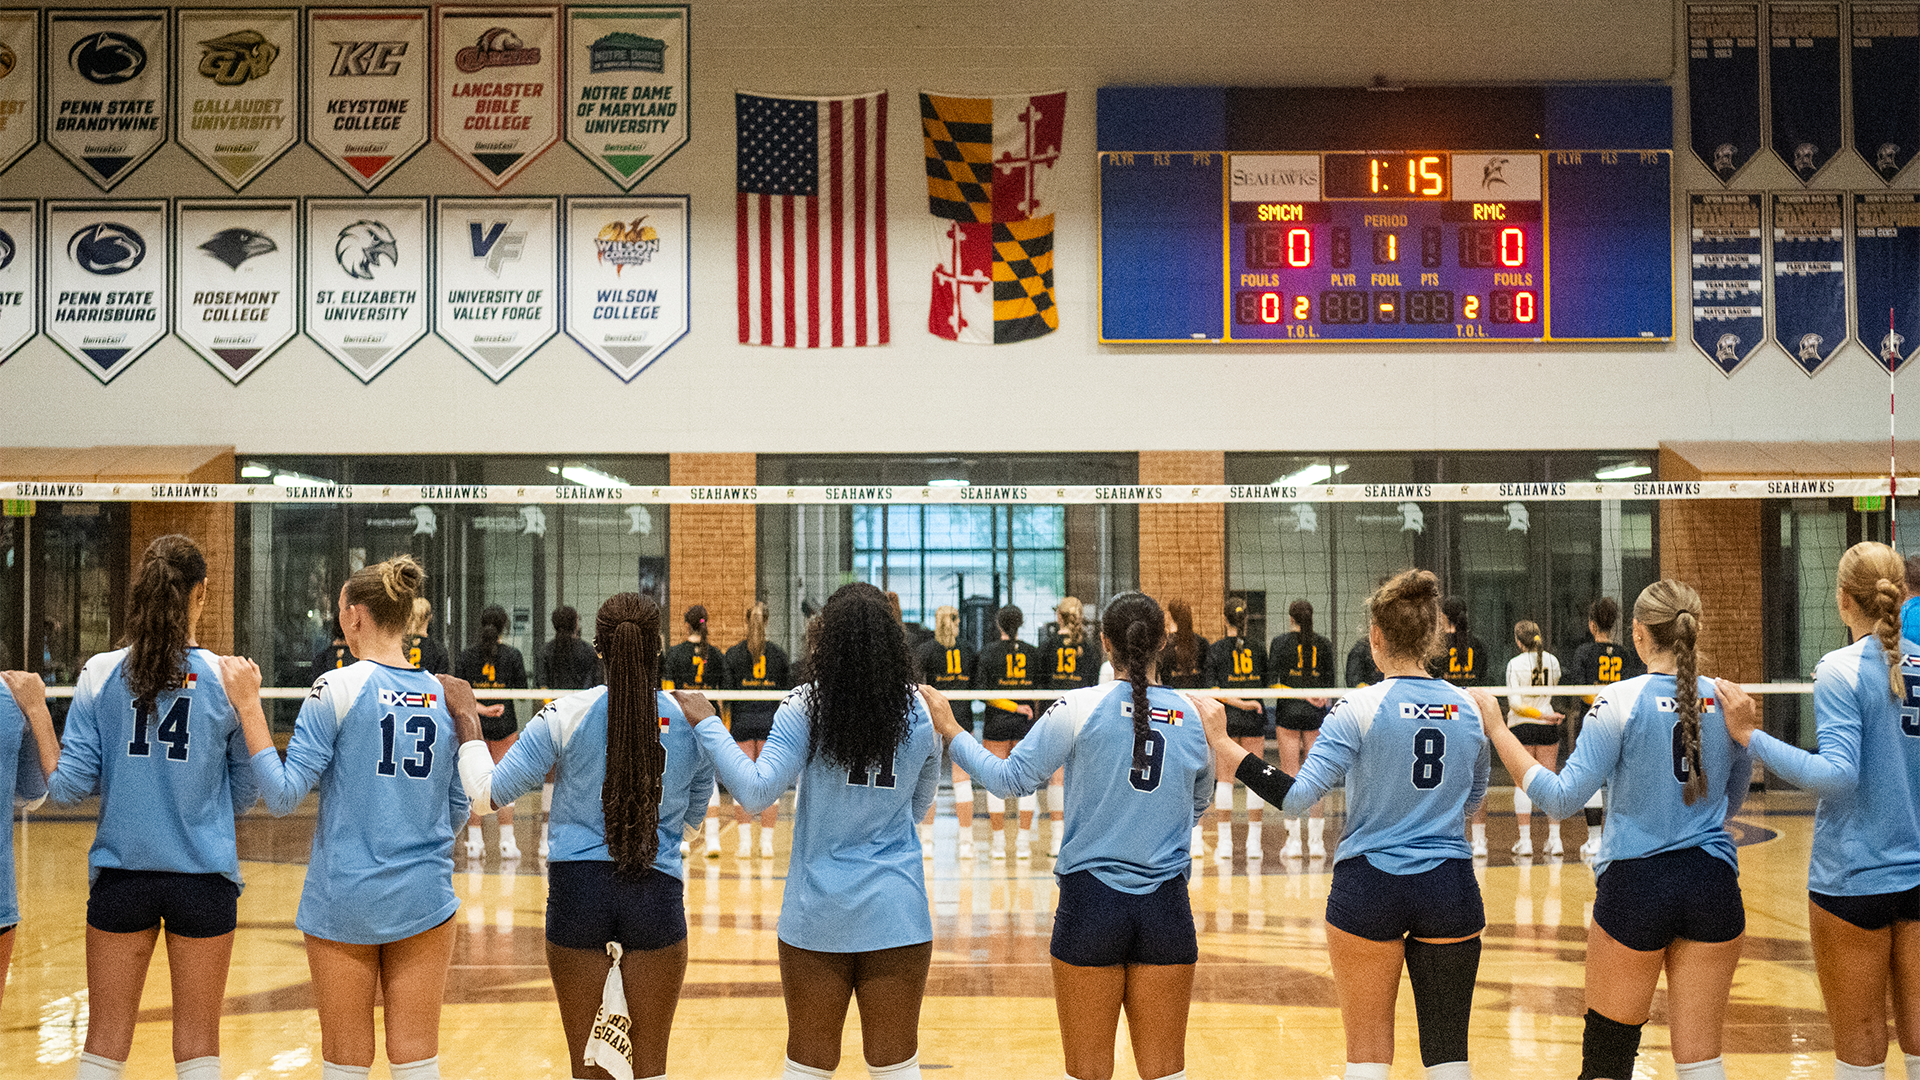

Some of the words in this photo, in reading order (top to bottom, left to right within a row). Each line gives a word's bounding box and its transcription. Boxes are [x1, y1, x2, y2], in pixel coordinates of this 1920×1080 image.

[452, 82, 545, 98] LANCASTER
[582, 86, 632, 100] NOTRE
[633, 86, 673, 100] DAME
[60, 100, 101, 115] PENN
[107, 100, 155, 115] STATE
[193, 99, 284, 114] GALLAUDET
[327, 98, 410, 114] KEYSTONE
[475, 99, 520, 114] BIBLE
[577, 103, 595, 117] OF
[600, 103, 677, 117] MARYLAND
[56, 116, 160, 131] BRANDYWINE
[191, 116, 285, 131] UNIVERSITY
[333, 115, 401, 131] COLLEGE
[464, 116, 533, 131] COLLEGE
[585, 119, 670, 134] UNIVERSITY
[1109, 153, 1134, 166] PLYR
[1153, 153, 1170, 166] FLS
[1193, 153, 1211, 166] PTS
[1557, 152, 1582, 165] PLYR
[1601, 152, 1618, 165] FLS
[1641, 152, 1658, 165] PTS
[1233, 169, 1318, 186] SEAHAWKS
[1371, 157, 1443, 195] 1:15
[1258, 204, 1303, 221] SMCM
[1473, 203, 1506, 221] RMC
[1364, 214, 1408, 228] PERIOD
[594, 238, 660, 254] WILSON
[1288, 228, 1311, 268] 0
[1501, 227, 1524, 267] 0
[1240, 273, 1280, 287] FOULS
[1331, 273, 1356, 287] PLYR
[1371, 273, 1401, 287] FOUL
[1420, 273, 1439, 287] PTS
[1494, 272, 1533, 287] FOULS
[59, 291, 101, 305] PENN
[106, 291, 154, 305] STATE
[193, 291, 280, 306] ROSEMONT
[316, 291, 337, 305] ST.
[342, 290, 417, 304] ELIZABETH
[449, 289, 524, 304] UNIVERSITY
[527, 289, 543, 304] OF
[597, 289, 658, 303] WILSON
[55, 307, 157, 322] HARRISBURG
[203, 307, 270, 322] COLLEGE
[324, 307, 409, 321] UNIVERSITY
[453, 306, 498, 321] VALLEY
[502, 306, 543, 321] FORGE
[593, 306, 660, 321] COLLEGE
[1261, 292, 1280, 324] 0
[1294, 295, 1310, 320] 2
[1464, 295, 1479, 320] 2
[1515, 291, 1534, 323] 0
[1286, 325, 1320, 338] T.O.L.
[1456, 324, 1489, 338] T.O.L.
[17, 483, 83, 497] SEAHAWKS
[151, 485, 218, 498] SEAHAWKS
[286, 485, 353, 499] SEAHAWKS
[421, 486, 487, 500] SEAHAWKS
[556, 487, 623, 500] SEAHAWKS
[691, 487, 758, 500] SEAHAWKS
[826, 487, 893, 500] SEAHAWKS
[960, 487, 1028, 500] SEAHAWKS
[1095, 487, 1162, 500] SEAHAWKS
[1230, 486, 1297, 499] SEAHAWKS
[1364, 485, 1432, 498] SEAHAWKS
[1500, 483, 1566, 497] SEAHAWKS
[1634, 482, 1700, 496] SEAHAWKS
[1768, 481, 1835, 494] SEAHAWKS
[946, 649, 962, 675] 11
[1006, 653, 1027, 679] 12
[1057, 647, 1077, 673] 13
[1232, 648, 1254, 675] 16
[482, 662, 496, 681] 4
[692, 655, 704, 683] 7
[1599, 655, 1623, 682] 22
[127, 696, 192, 762] 14
[376, 711, 438, 779] 13
[1128, 728, 1168, 794] 9
[1411, 726, 1446, 792] 8
